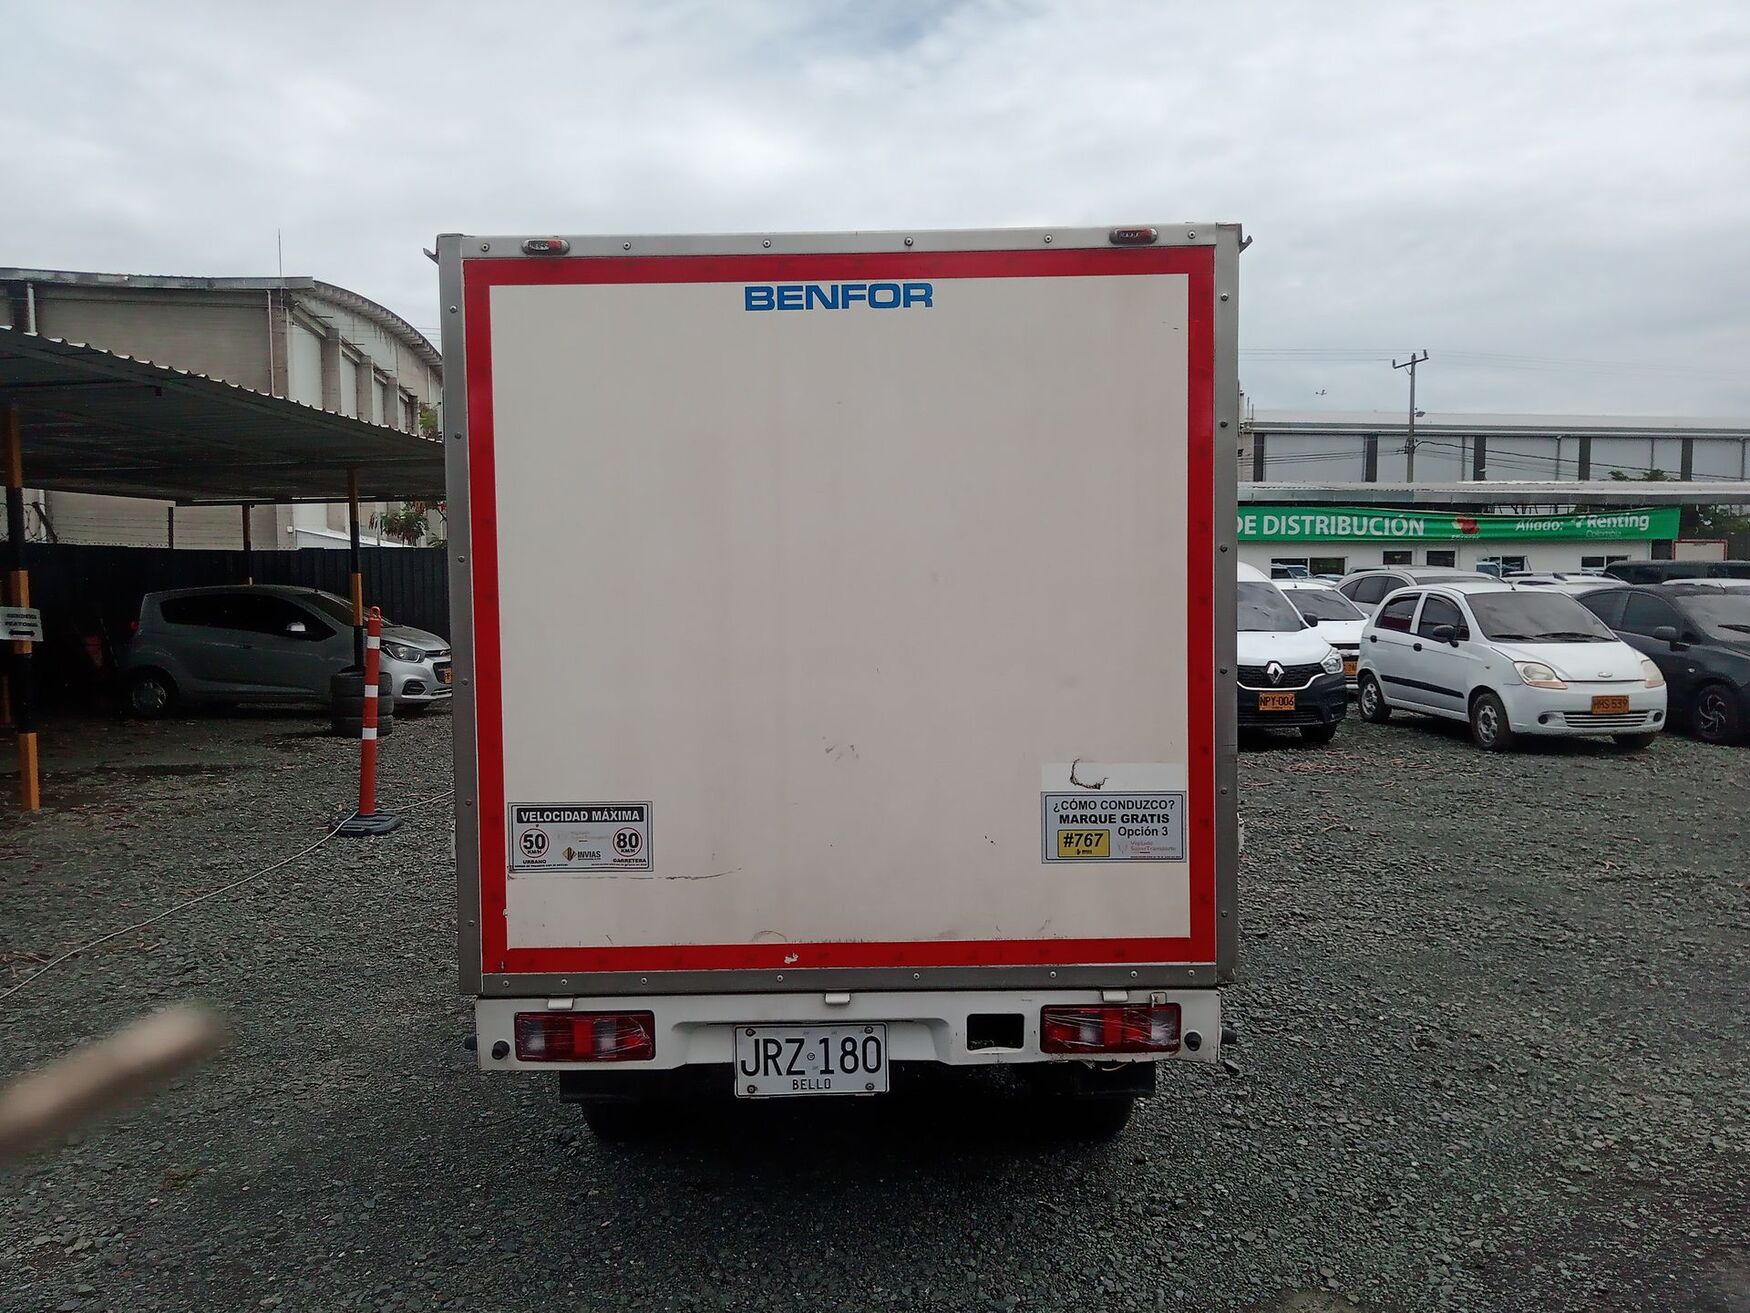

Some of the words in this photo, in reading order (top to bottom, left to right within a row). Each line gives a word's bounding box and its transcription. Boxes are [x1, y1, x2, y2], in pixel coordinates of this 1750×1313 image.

[745, 283, 933, 311] BENFOR
[1263, 514, 1425, 536] DISTRIBUCIÓN
[1587, 515, 1650, 531] Renting
[1053, 798, 1097, 813] ¿CÓMO
[1100, 800, 1175, 810] CONDUZCO?
[521, 810, 588, 822] VELOCIDAD
[592, 808, 640, 821] MÁXIMA
[1059, 814, 1116, 824] MARQUE
[1121, 813, 1170, 824] GRATIS
[1118, 826, 1159, 838] Opción
[1162, 827, 1169, 836] 3
[523, 833, 546, 849] 50
[616, 832, 639, 849] 80
[1063, 833, 1104, 848] #767
[577, 850, 601, 859] INVIAS
[741, 1038, 806, 1076] JRZ
[819, 1036, 882, 1074] 180
[792, 1078, 832, 1090] BELLO
